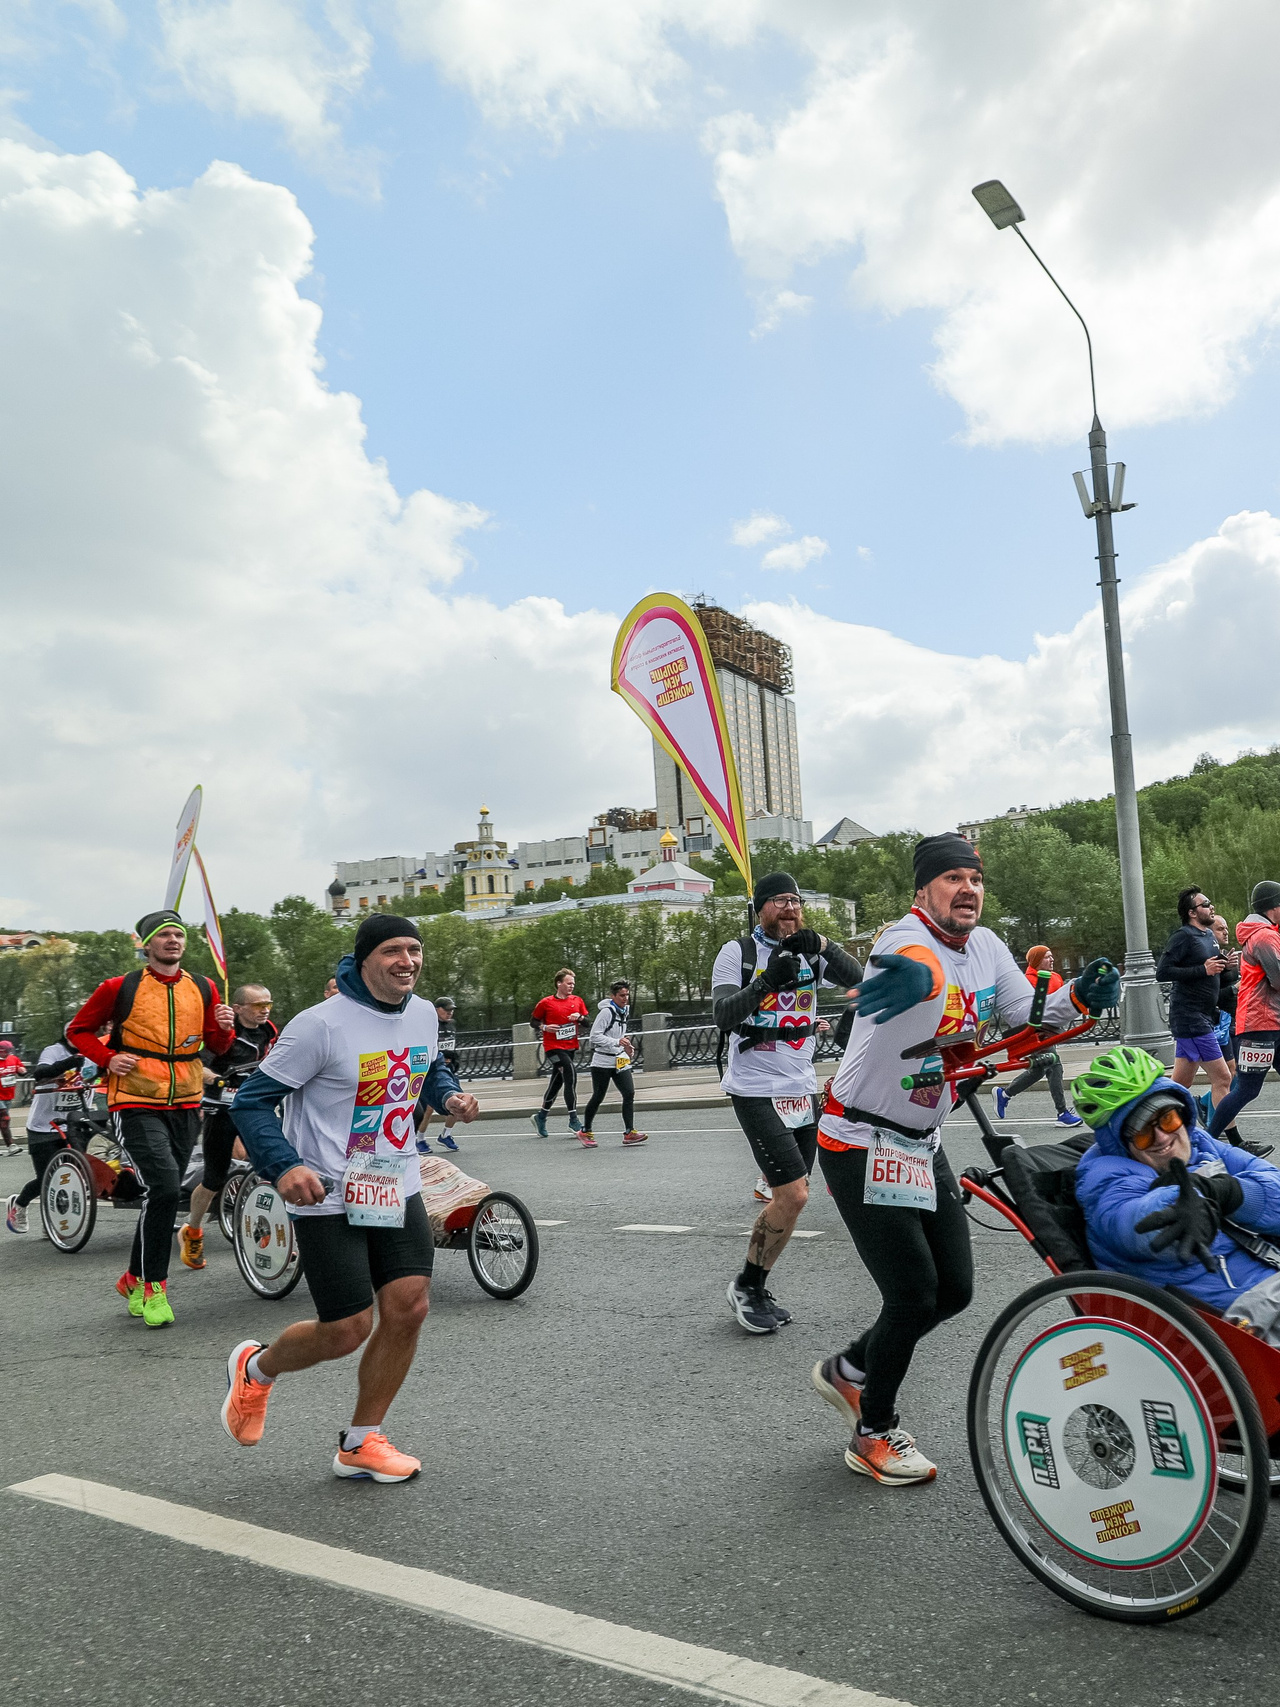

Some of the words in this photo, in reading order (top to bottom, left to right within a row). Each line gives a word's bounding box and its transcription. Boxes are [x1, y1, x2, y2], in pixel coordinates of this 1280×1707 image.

[1242, 1051, 1273, 1063] 18920
[874, 1147, 929, 1168] СОПРОВОЖДЕНИЕ
[349, 1171, 399, 1186] СОПРОВОЖДЕНИЕ
[872, 1158, 934, 1191] БЕГУНА
[345, 1181, 401, 1207] БЕГУНА
[1152, 1402, 1186, 1471] ПАРИ
[1022, 1420, 1051, 1486] ПАРИ
[1090, 1500, 1133, 1521] МОЖЕШЬ
[1096, 1522, 1136, 1543] БОЛЬШЕ
[1104, 1515, 1126, 1530] ЧЕМ
